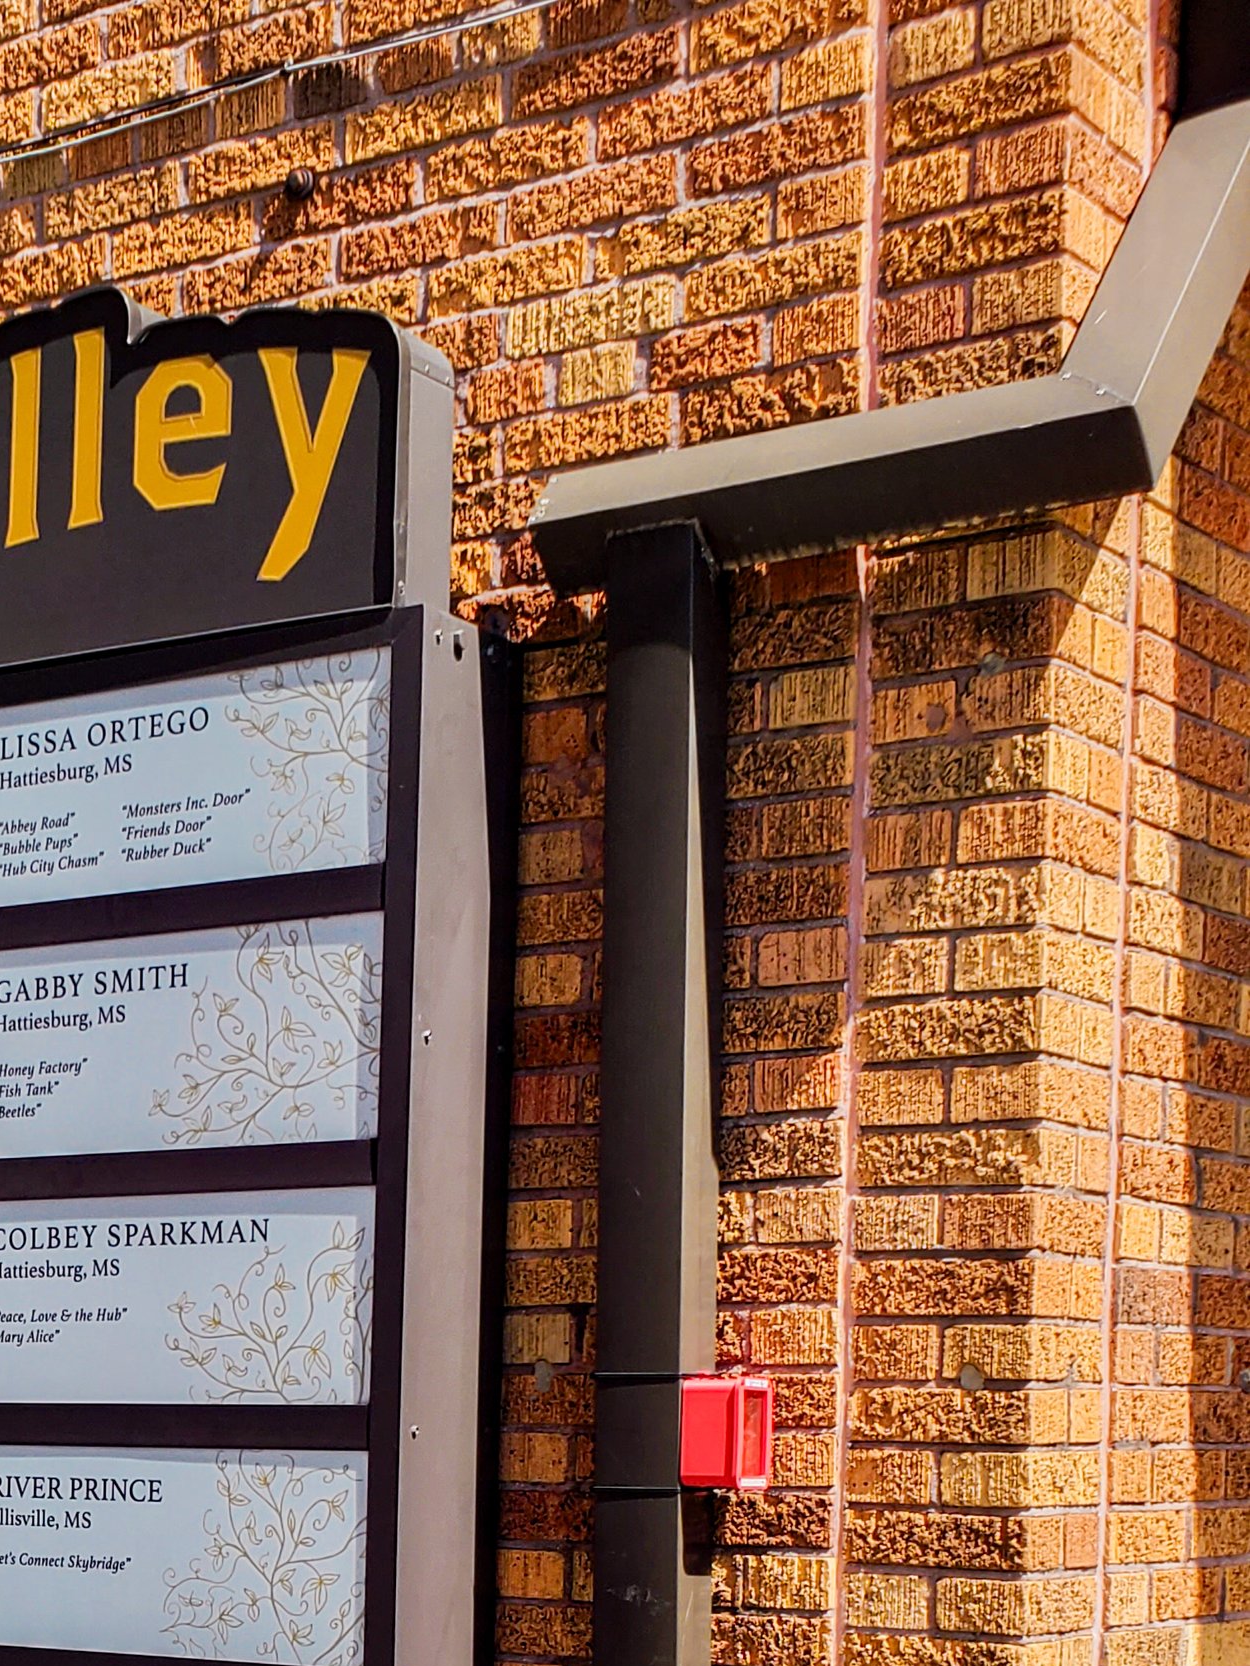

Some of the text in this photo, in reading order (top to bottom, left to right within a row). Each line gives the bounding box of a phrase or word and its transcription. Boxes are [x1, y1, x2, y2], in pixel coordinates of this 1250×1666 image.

[0, 707, 209, 761] LISSA ORTEGO
[0, 753, 132, 790] Hattiesburg, MS
[186, 796, 208, 811] Inc.
[30, 859, 54, 876] City
[94, 963, 188, 995] SMITH
[98, 1004, 125, 1025] MS
[107, 1218, 269, 1247] SPARKMAN
[92, 1258, 120, 1277] MS
[30, 1309, 57, 1322] Love
[60, 1309, 72, 1322] &
[75, 1308, 93, 1322] the
[69, 1477, 163, 1502] PRINCE
[64, 1511, 91, 1529] MS
[19, 1553, 65, 1568] Connect
